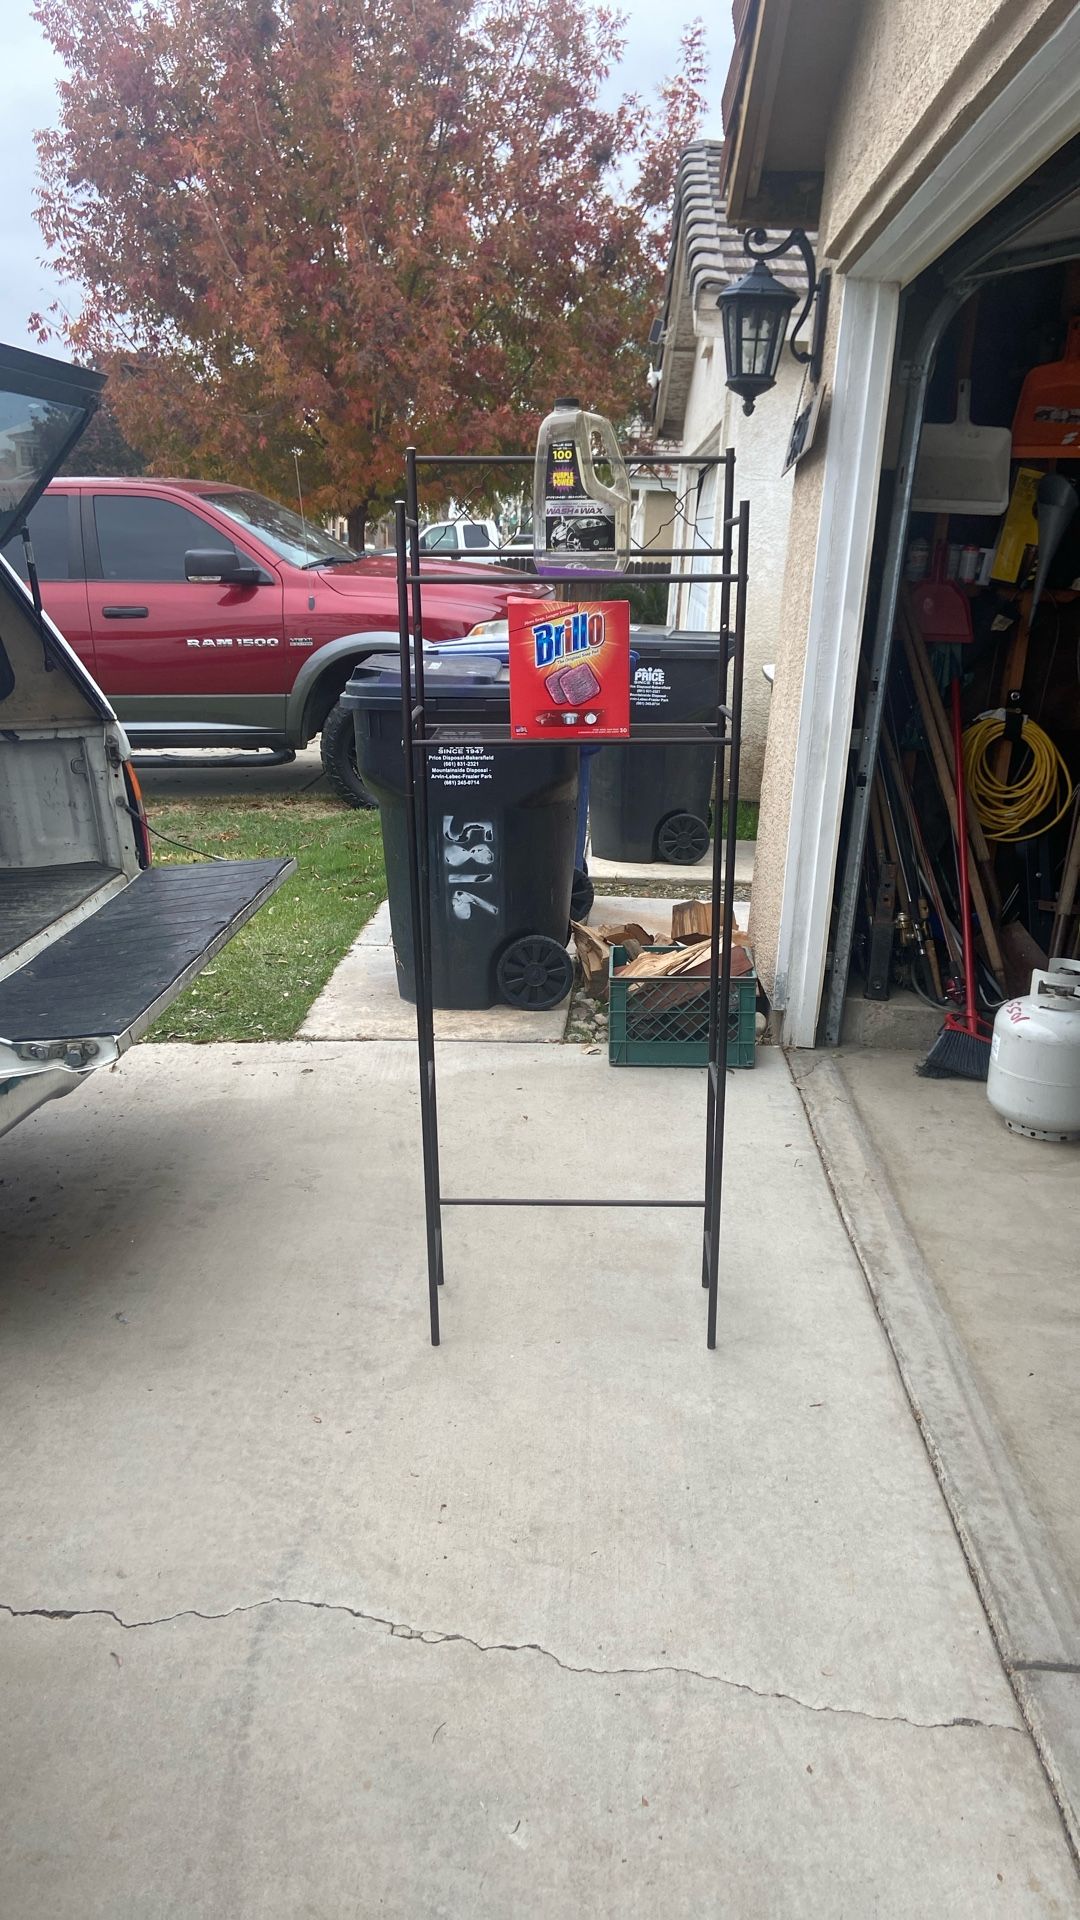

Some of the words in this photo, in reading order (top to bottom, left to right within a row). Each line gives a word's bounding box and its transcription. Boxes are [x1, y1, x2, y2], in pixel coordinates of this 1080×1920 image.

[552, 450, 573, 460] 100
[553, 478, 574, 487] POWER
[546, 507, 574, 515] WASH
[186, 638, 232, 648] RAM
[237, 638, 279, 647] 1500
[532, 610, 606, 668] Brillo
[634, 670, 665, 681] PRICE
[443, 815, 498, 919] 5816
